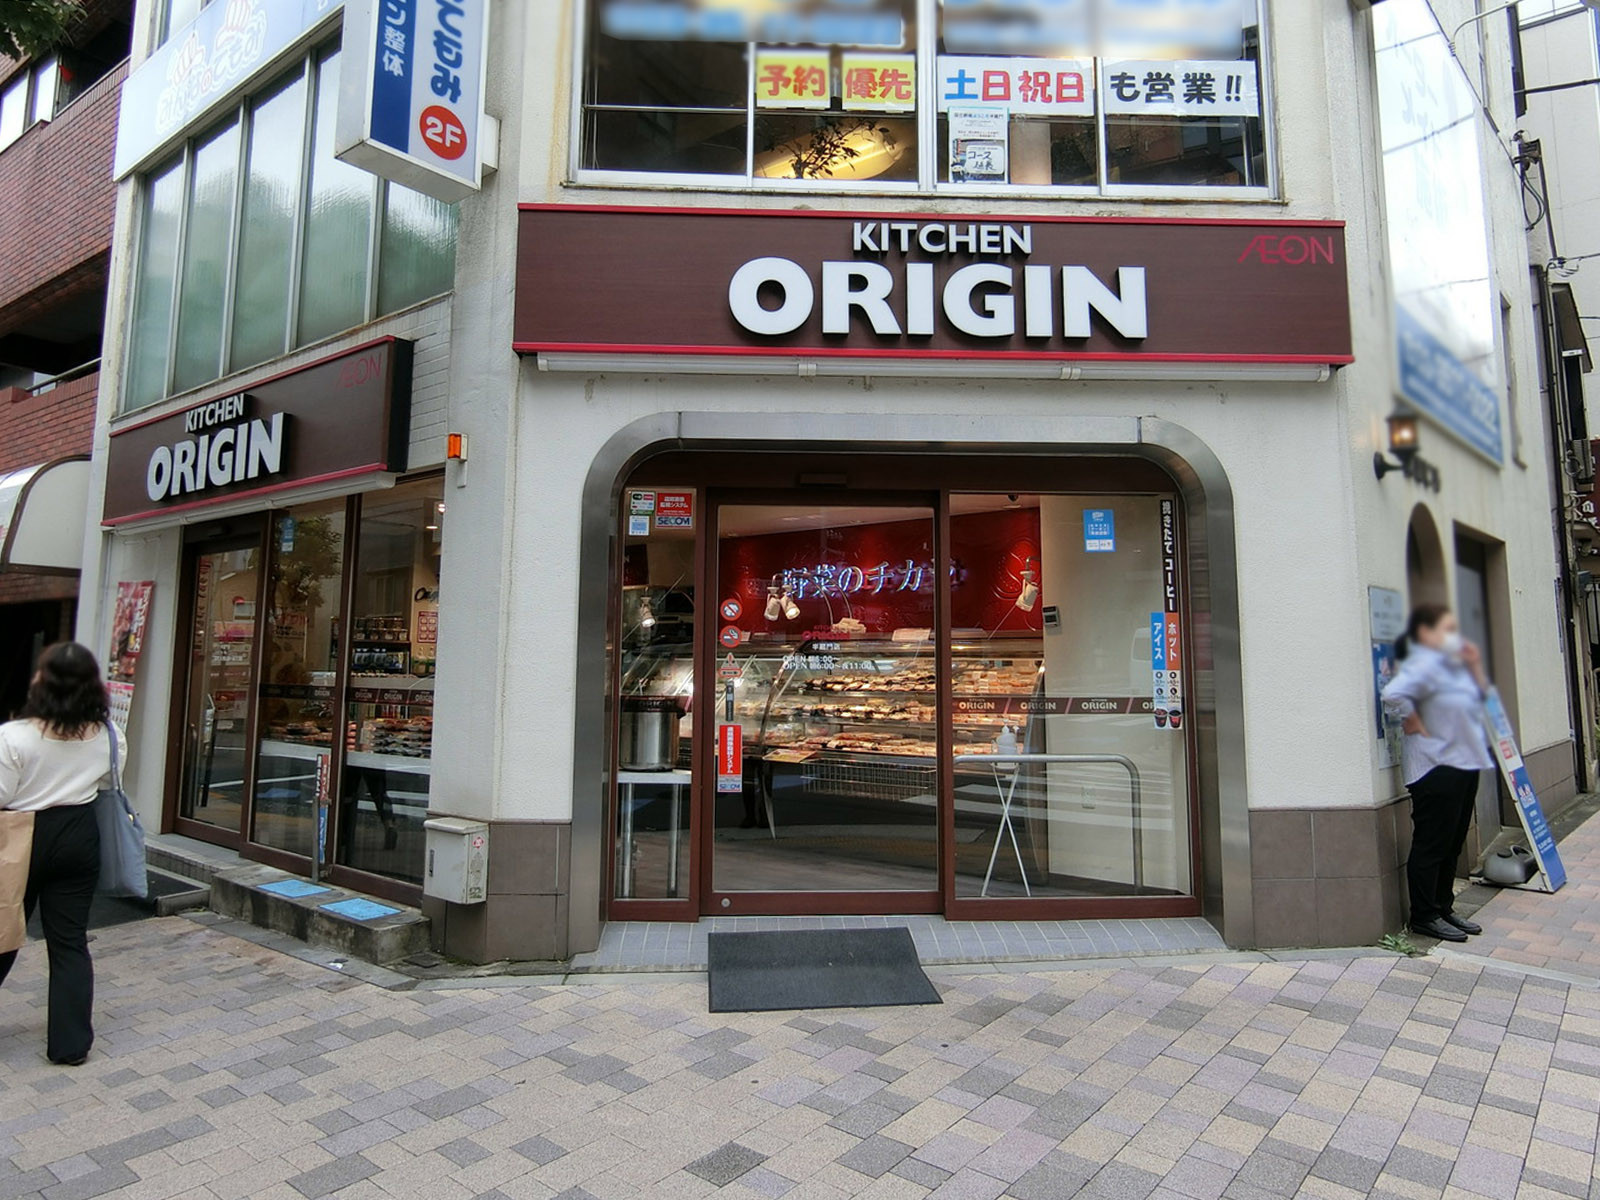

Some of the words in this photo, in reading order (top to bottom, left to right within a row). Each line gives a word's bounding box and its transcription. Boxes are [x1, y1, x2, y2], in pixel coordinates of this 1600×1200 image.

[383, 0, 407, 77] ン整体
[431, 0, 466, 104] てもみ
[760, 64, 826, 97] 予約
[845, 68, 912, 100] 優先
[945, 69, 1085, 103] 土日祝日
[425, 116, 463, 148] 2F
[853, 222, 1032, 255] KITCHEN
[729, 257, 1148, 339] ORIGIN
[185, 393, 244, 433] KITCHEN
[147, 412, 284, 502] ORIGIN
[657, 517, 690, 525] SECOM
[1165, 558, 1175, 611] コーヒー
[1153, 622, 1163, 660] アイス
[1167, 622, 1177, 661] ホット
[959, 701, 995, 710] ORIGIN
[1020, 702, 1056, 710] ORIGIN
[1082, 701, 1117, 710] ORIGIN
